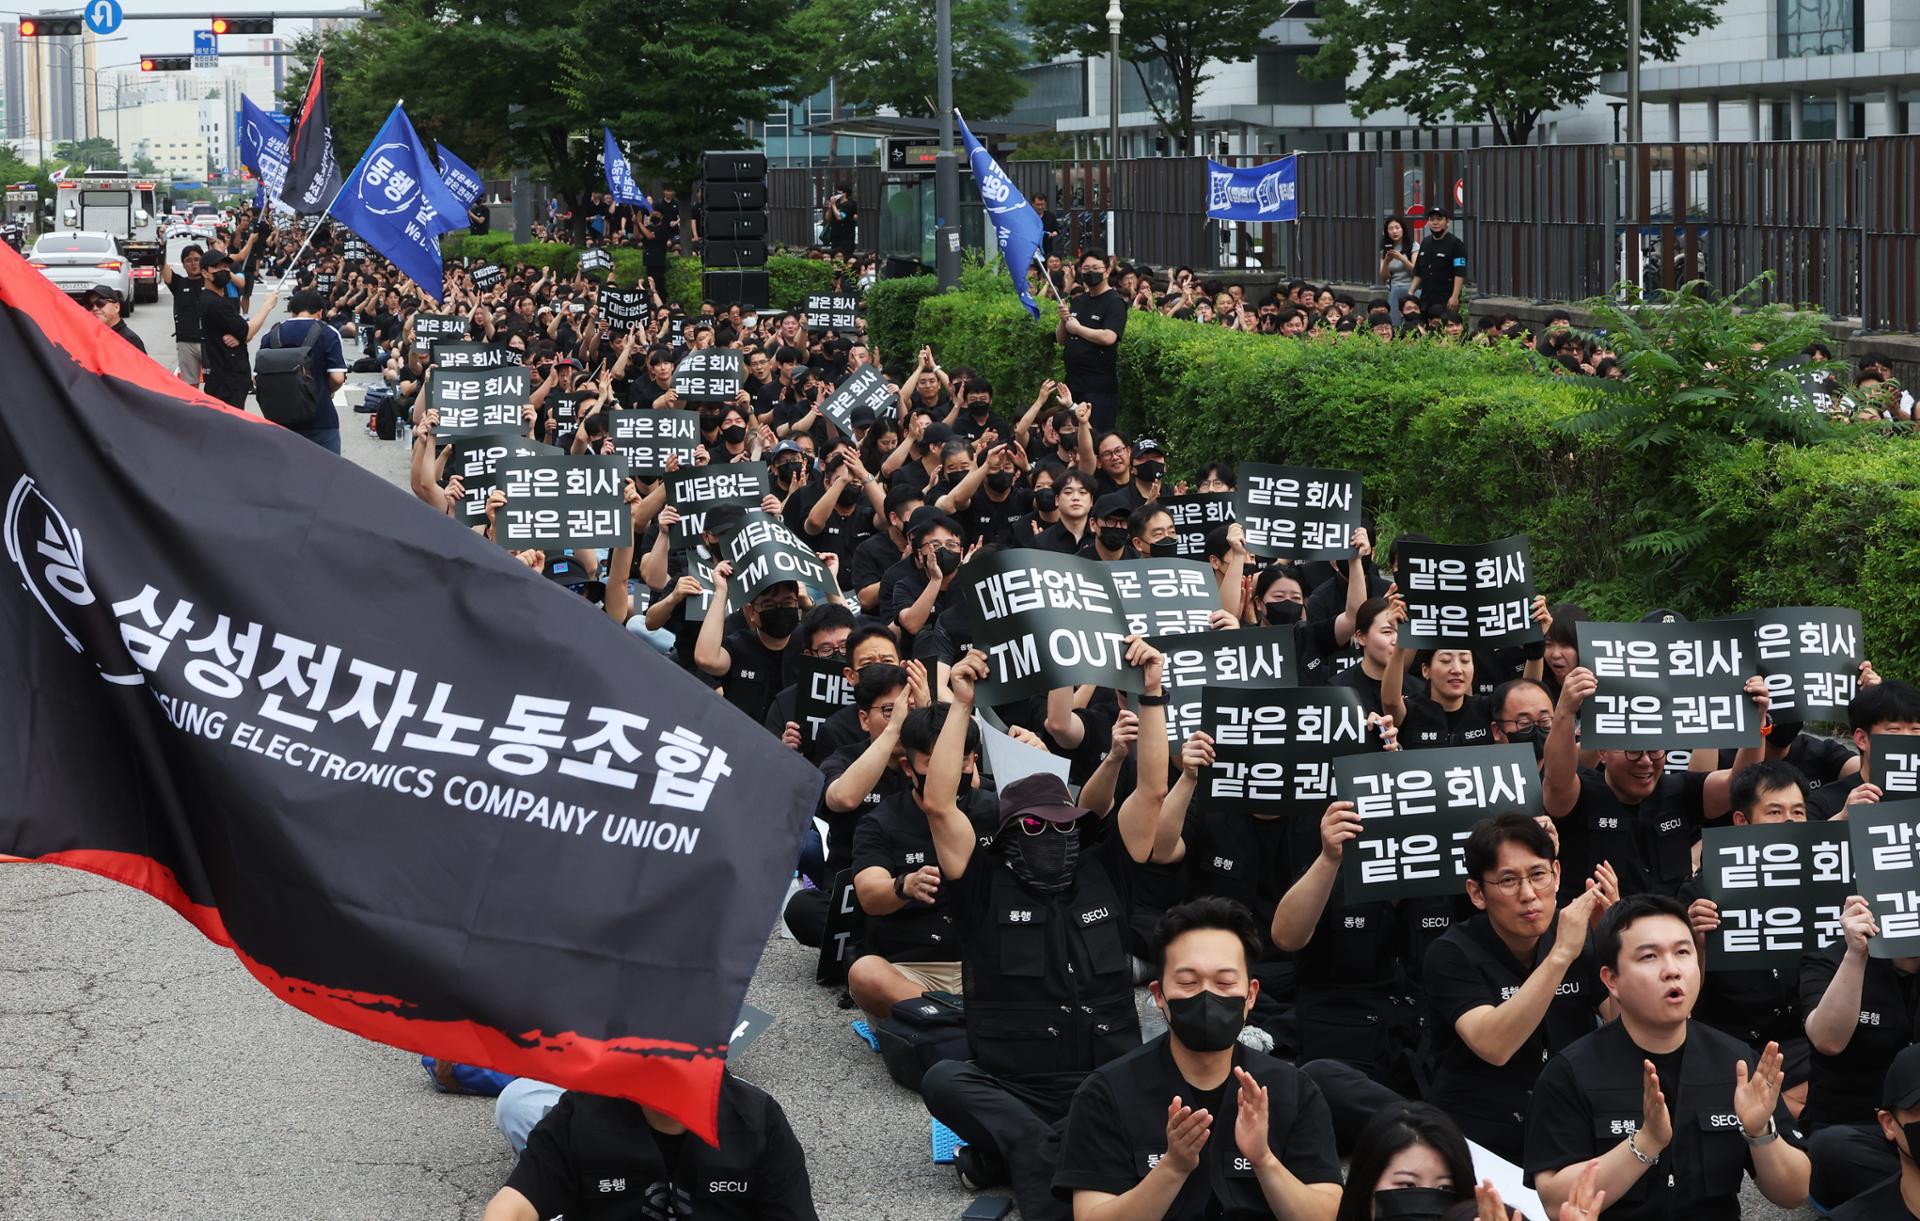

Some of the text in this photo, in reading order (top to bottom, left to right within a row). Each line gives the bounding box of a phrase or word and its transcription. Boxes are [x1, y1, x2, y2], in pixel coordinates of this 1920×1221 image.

[366, 156, 416, 202] 동행
[404, 221, 421, 240] We
[609, 302, 648, 316] 대답없는
[809, 296, 855, 309] 같은 회사
[417, 320, 465, 333] 같은 회사
[608, 316, 624, 329] TM
[808, 314, 855, 327] 같은 권리
[440, 349, 501, 367] 같은 회사
[709, 355, 739, 371] 회사
[441, 376, 523, 400] 같은 회사
[676, 378, 740, 395] 같은 권리
[826, 370, 878, 417] 같은 회사
[439, 404, 522, 427] 같은 권리
[558, 400, 576, 416] 같
[558, 422, 579, 436] 같
[616, 417, 696, 439] 같은 회사
[505, 468, 620, 497] 같은 회사
[675, 473, 760, 503] 대답없는
[1248, 477, 1353, 511] 같은 회사
[465, 486, 497, 515] 같
[1168, 503, 1203, 526] 같은
[507, 509, 621, 539] 같은 권리
[1245, 516, 1350, 549] 같은 권리
[730, 520, 817, 563] 대답없는
[737, 554, 769, 594] TM
[774, 551, 824, 583] OUT
[1409, 551, 1525, 591] 같은 회사
[975, 568, 1113, 621] 대답없는
[1410, 597, 1531, 637] 같은 권리
[1754, 622, 1857, 659] 은 회사
[990, 628, 1126, 684] TM OUT
[1214, 643, 1284, 681] 회사
[1592, 638, 1742, 679] 같은 회사
[112, 583, 733, 812] 삼성전자노동조합
[1764, 672, 1856, 711] 은 권리
[1215, 705, 1368, 745] 같은 회사
[1595, 695, 1745, 734] 같은 권리
[1464, 728, 1487, 740] SECU
[152, 690, 700, 855] SUNG ELECTRONICS COMPANY UNION
[1211, 762, 1284, 800] 같은
[1885, 753, 1920, 792] 같
[1353, 763, 1527, 819] 같은 회사
[1597, 817, 1618, 829] 동행
[1660, 818, 1682, 832] SECU
[905, 852, 925, 864] 동행
[1358, 834, 1441, 884] 같은
[1868, 822, 1920, 871] 같
[1213, 856, 1234, 871] 동행
[1719, 841, 1857, 888] 같은 회
[1008, 910, 1032, 922] 동행
[1081, 907, 1109, 924] SECU
[1344, 916, 1365, 928] 동행
[1421, 917, 1449, 928] SECU
[1721, 906, 1845, 952] 같은 권
[1876, 890, 1920, 939] 같
[1859, 1011, 1880, 1026] 동행
[1610, 1120, 1636, 1134] 동행
[1233, 1157, 1252, 1171] SE
[599, 1178, 626, 1193] 동행
[709, 1181, 748, 1193] SECU
